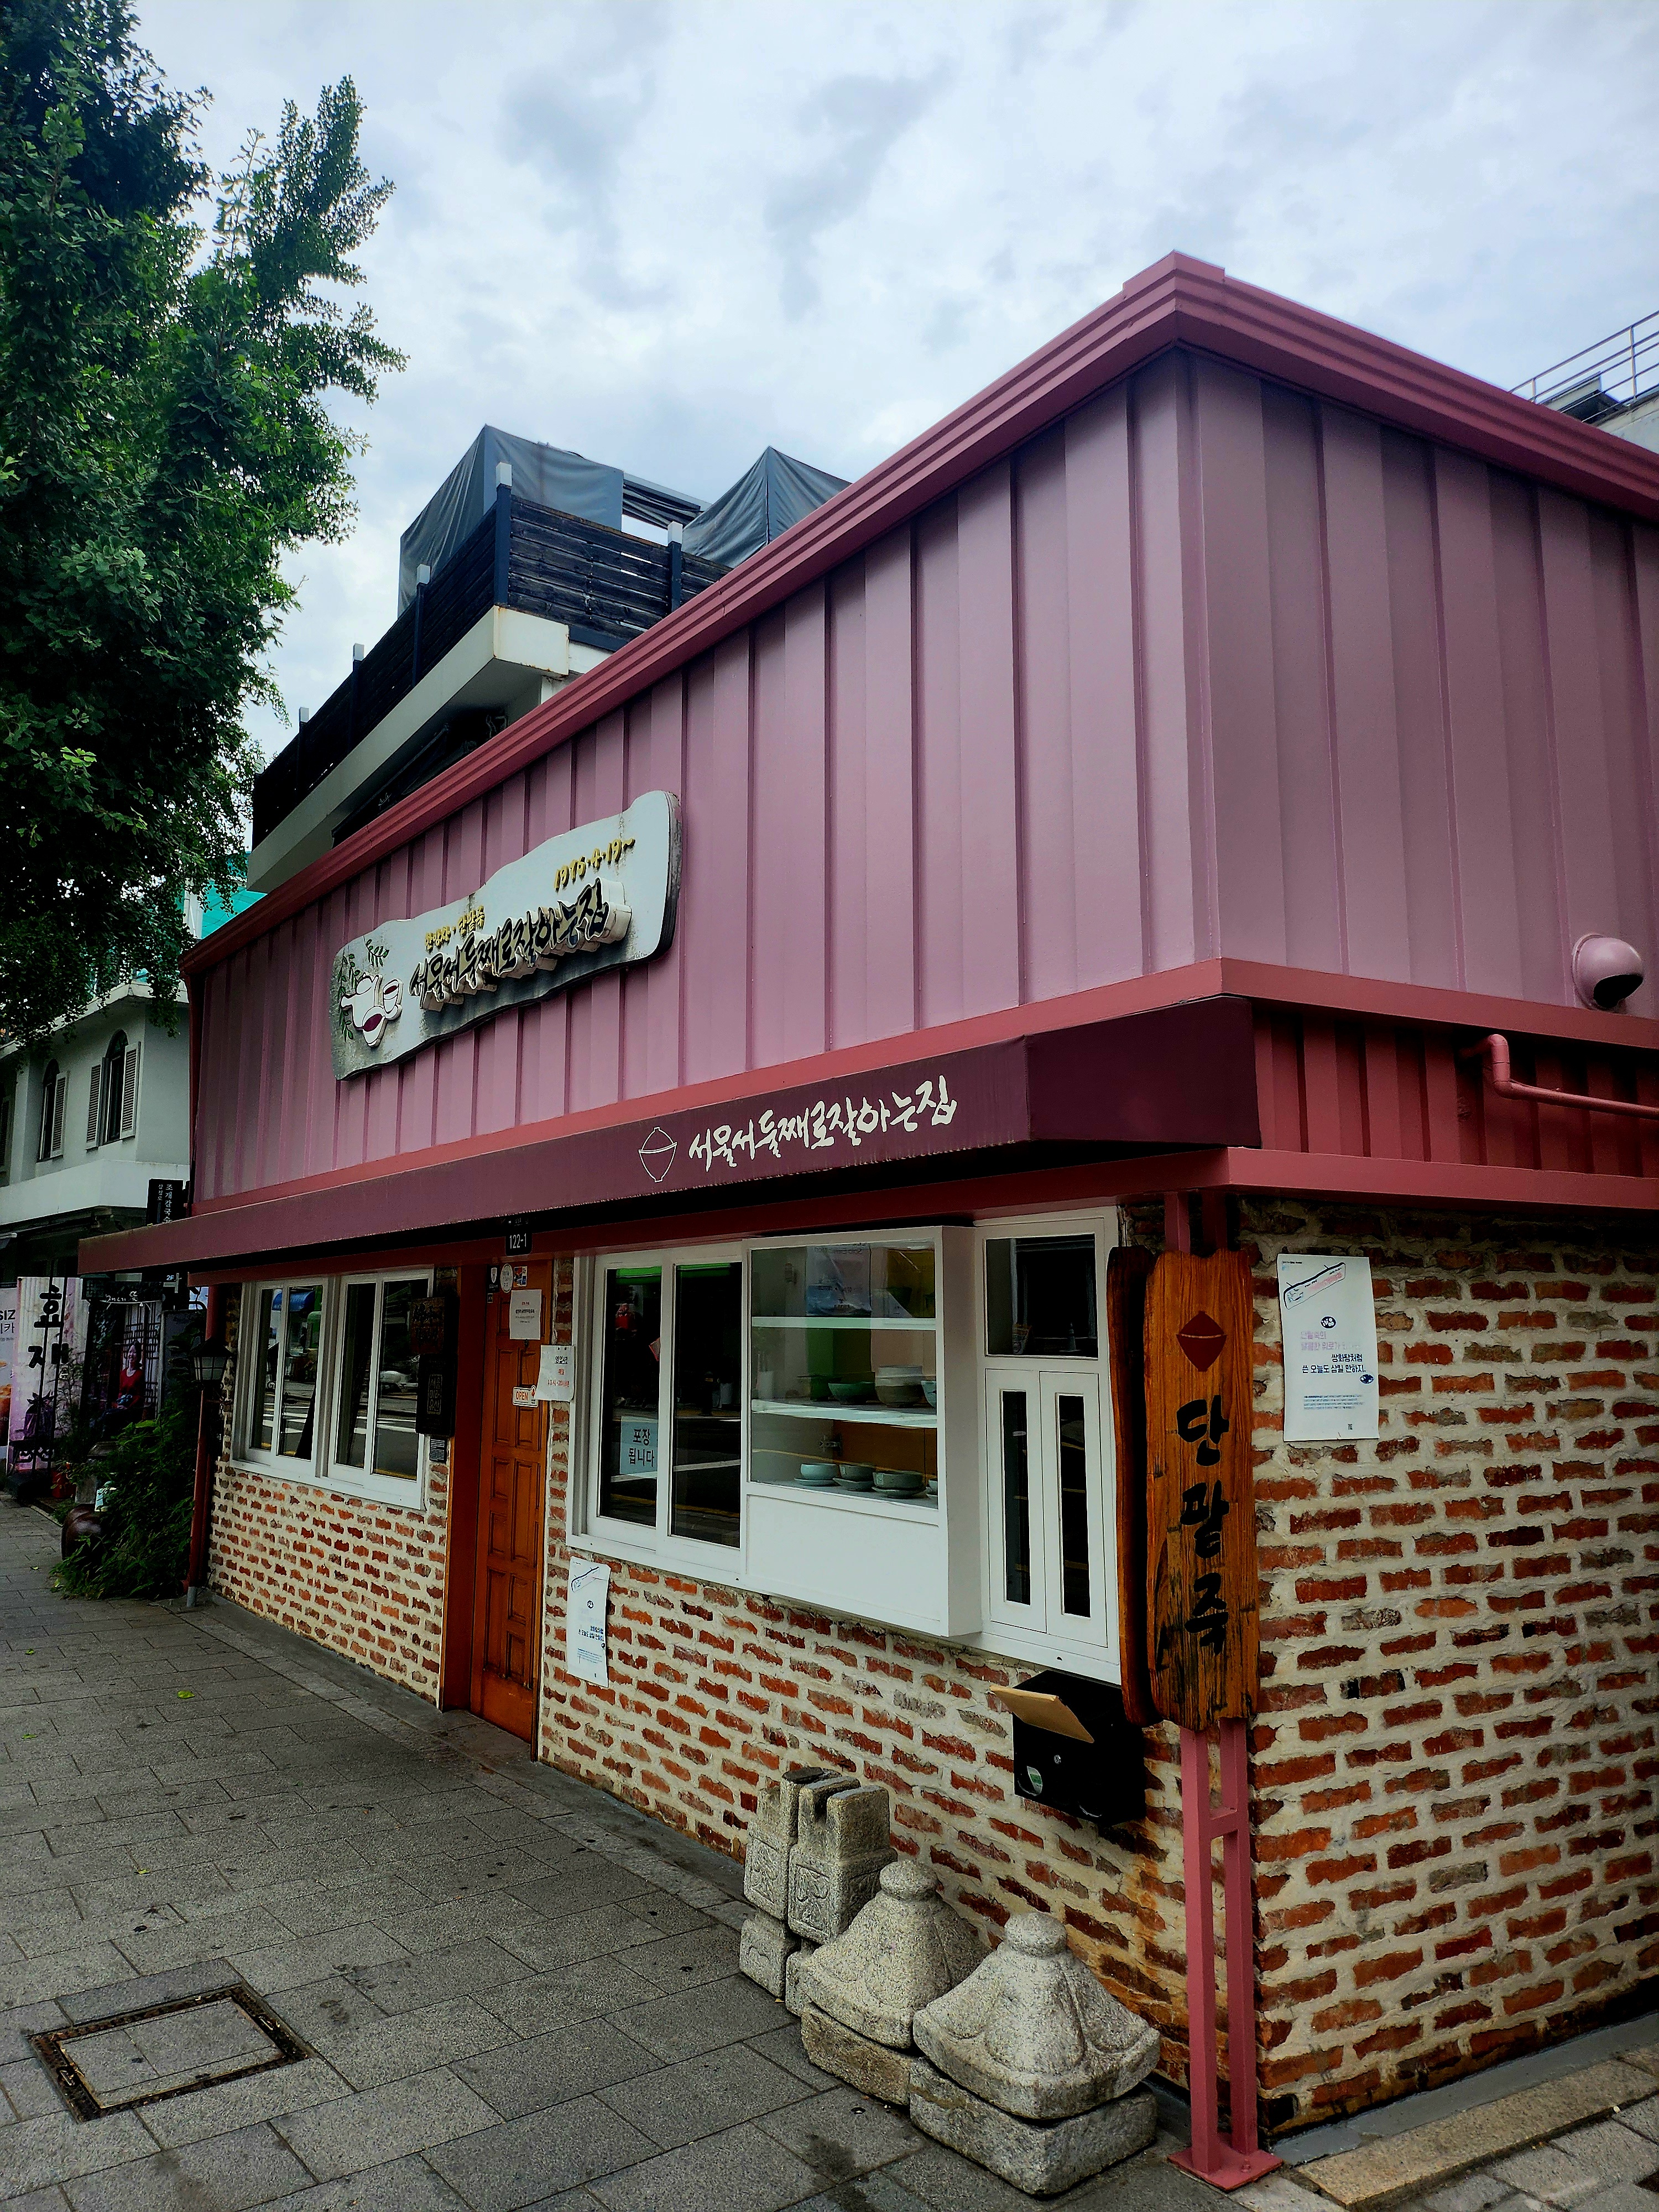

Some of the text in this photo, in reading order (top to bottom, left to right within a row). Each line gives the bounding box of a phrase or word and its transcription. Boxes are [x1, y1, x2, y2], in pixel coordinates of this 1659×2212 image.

[688, 1075, 957, 1172] 서울서둘째로잘하는집
[509, 1233, 526, 1249] 122-1
[1331, 1353, 1363, 1363] 쌍화탕처럼
[1311, 1365, 1330, 1373] 오늘도
[516, 1391, 528, 1401] OPEN
[632, 1428, 650, 1446] 포장
[628, 1448, 655, 1467] 됩니다
